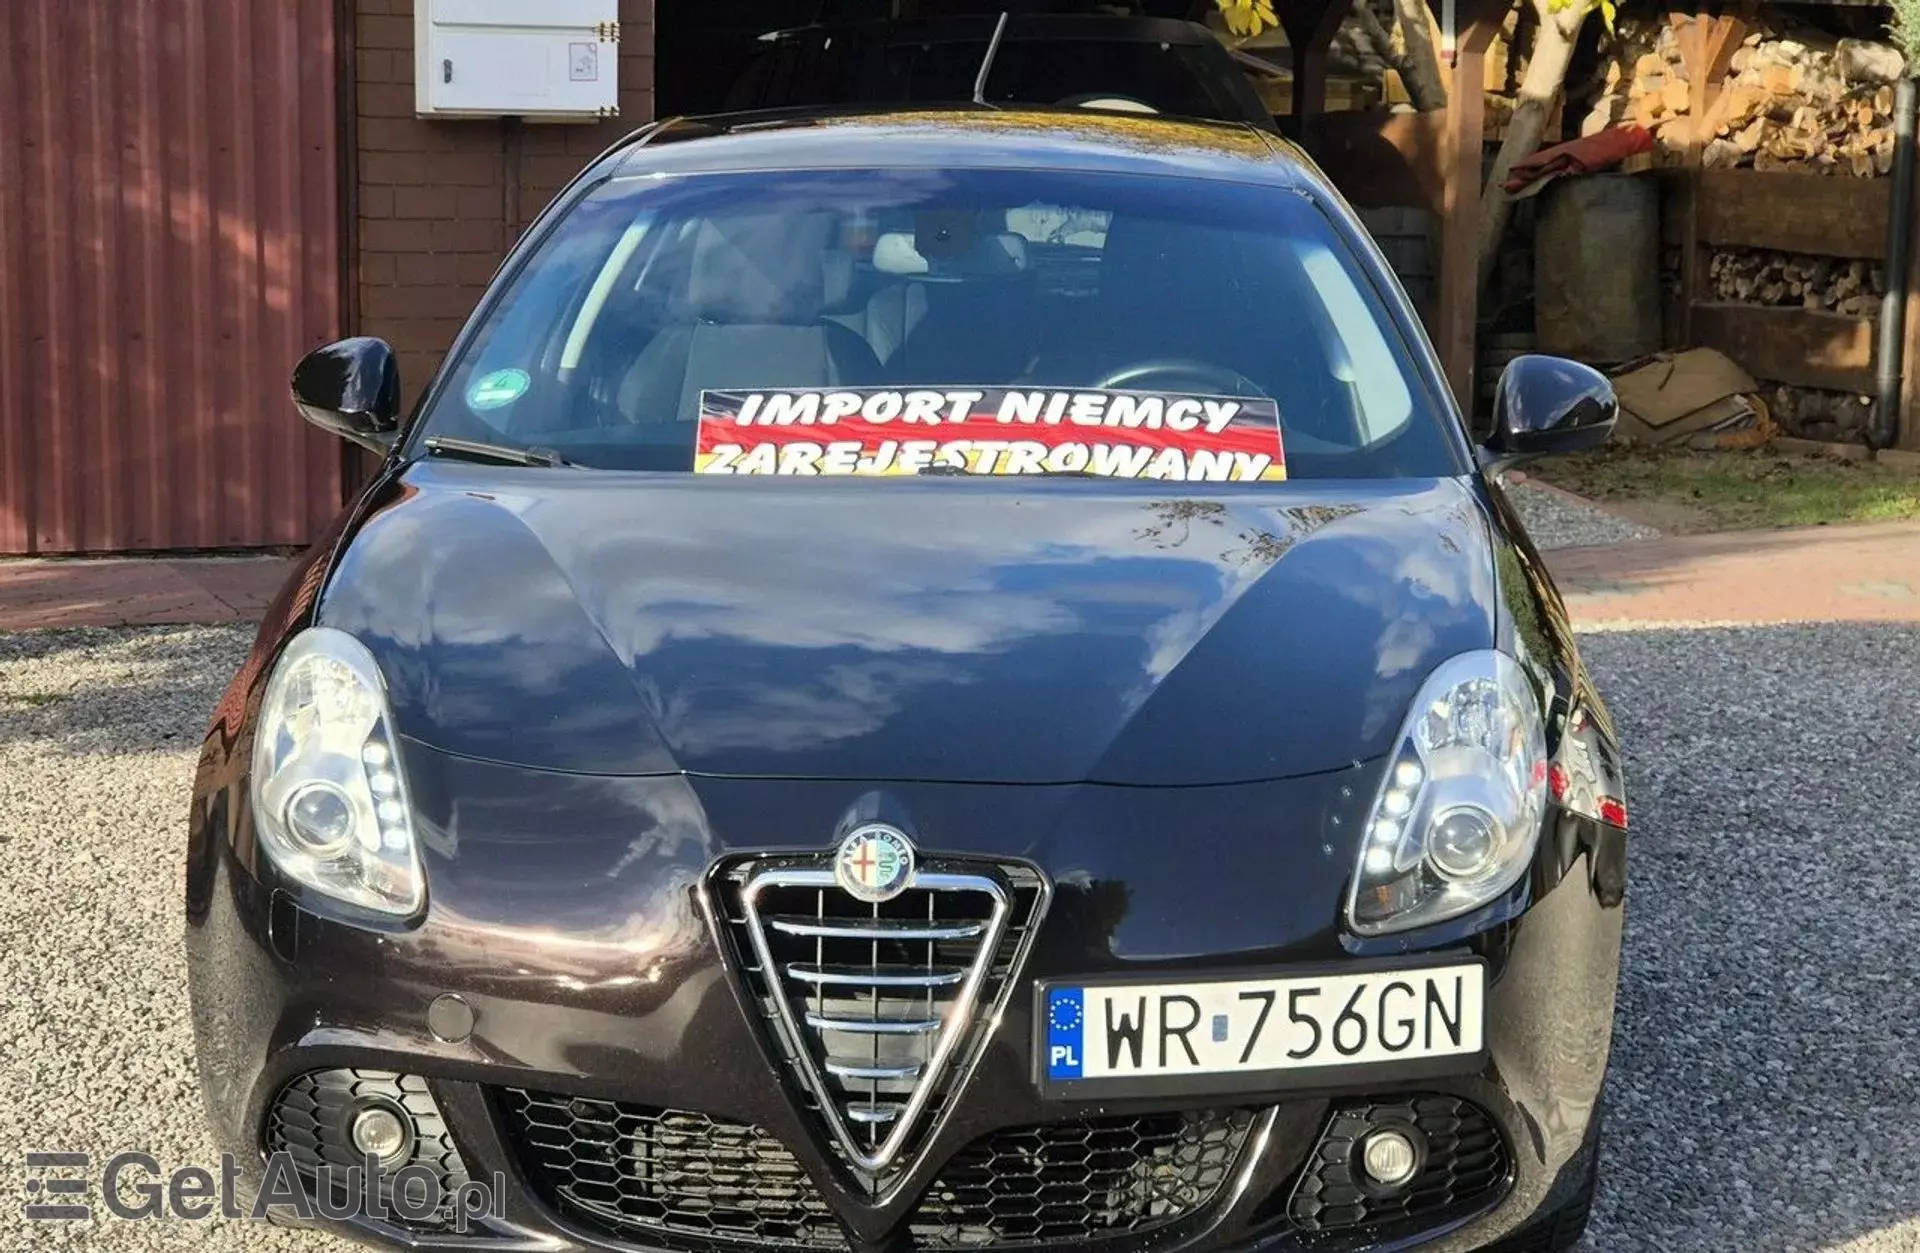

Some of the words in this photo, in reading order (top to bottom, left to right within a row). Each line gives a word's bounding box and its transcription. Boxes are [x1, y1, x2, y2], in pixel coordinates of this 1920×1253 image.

[735, 391, 985, 427] IMPORT
[995, 391, 1241, 434] NIEMCY
[703, 440, 1273, 481] ZAREJESTROWANY
[1104, 994, 1201, 1069] WR
[1238, 976, 1463, 1064] 756GN
[1050, 1045, 1079, 1067] PL
